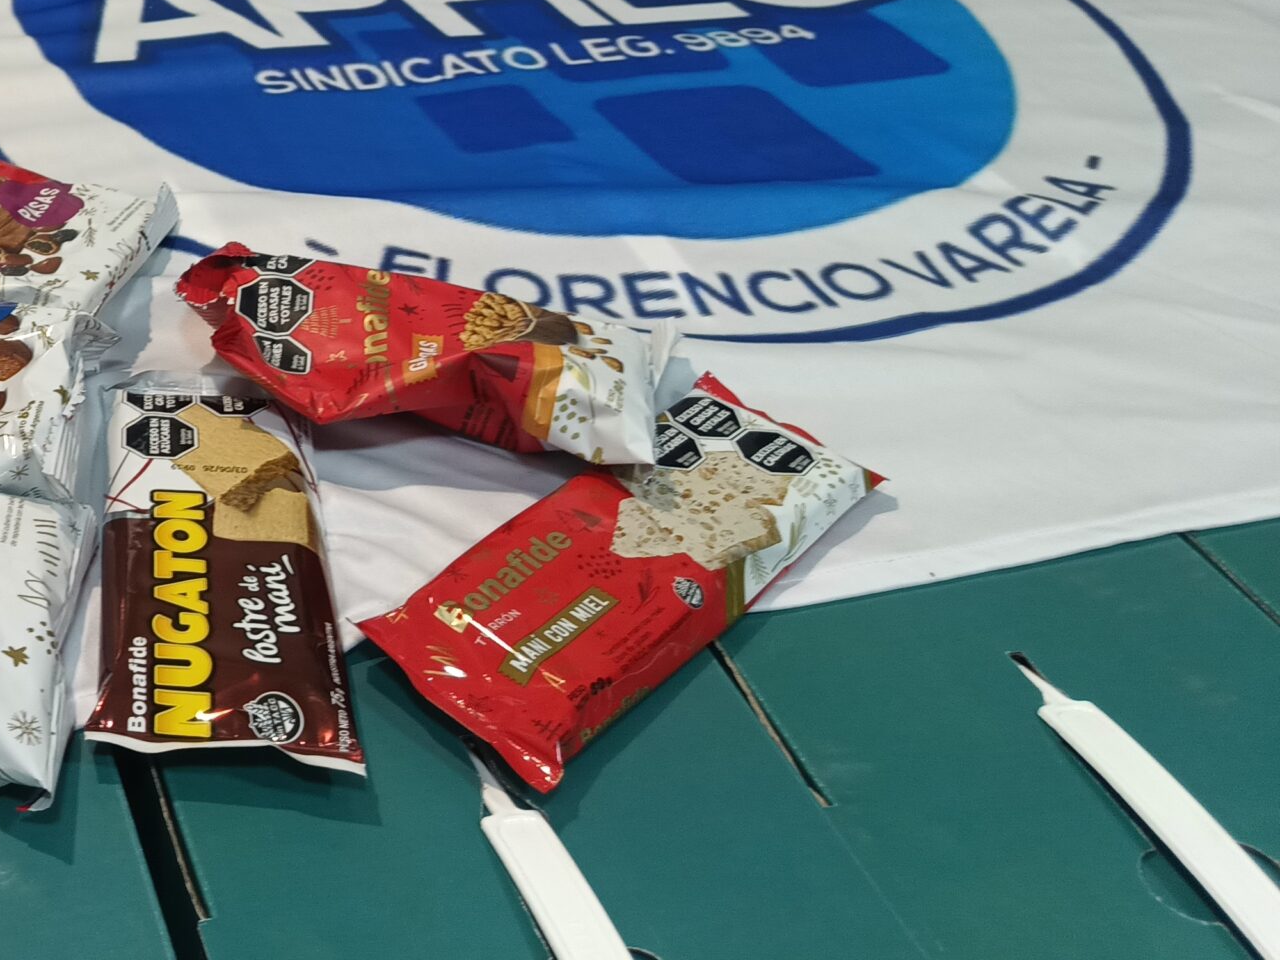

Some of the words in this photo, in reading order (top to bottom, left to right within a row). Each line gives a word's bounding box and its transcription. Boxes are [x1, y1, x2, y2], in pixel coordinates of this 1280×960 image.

[255, 43, 548, 96] SINDICATO
[552, 32, 675, 70] LEG.
[17, 187, 61, 222] PASAS
[882, 170, 1119, 291] VARELA
[259, 281, 269, 294] EN
[269, 287, 280, 324] GRASAS
[281, 285, 292, 325] TOTALES
[256, 295, 268, 328] EXCESO
[149, 427, 160, 454] EXCESO
[237, 569, 261, 591] de
[433, 530, 573, 634] Bonafide
[151, 490, 214, 738] NUGATON
[233, 590, 282, 664] Postre
[474, 608, 521, 646] TRRÓN
[543, 617, 579, 643] CON
[569, 594, 610, 623] MIEL
[127, 635, 149, 733] Bonafide
